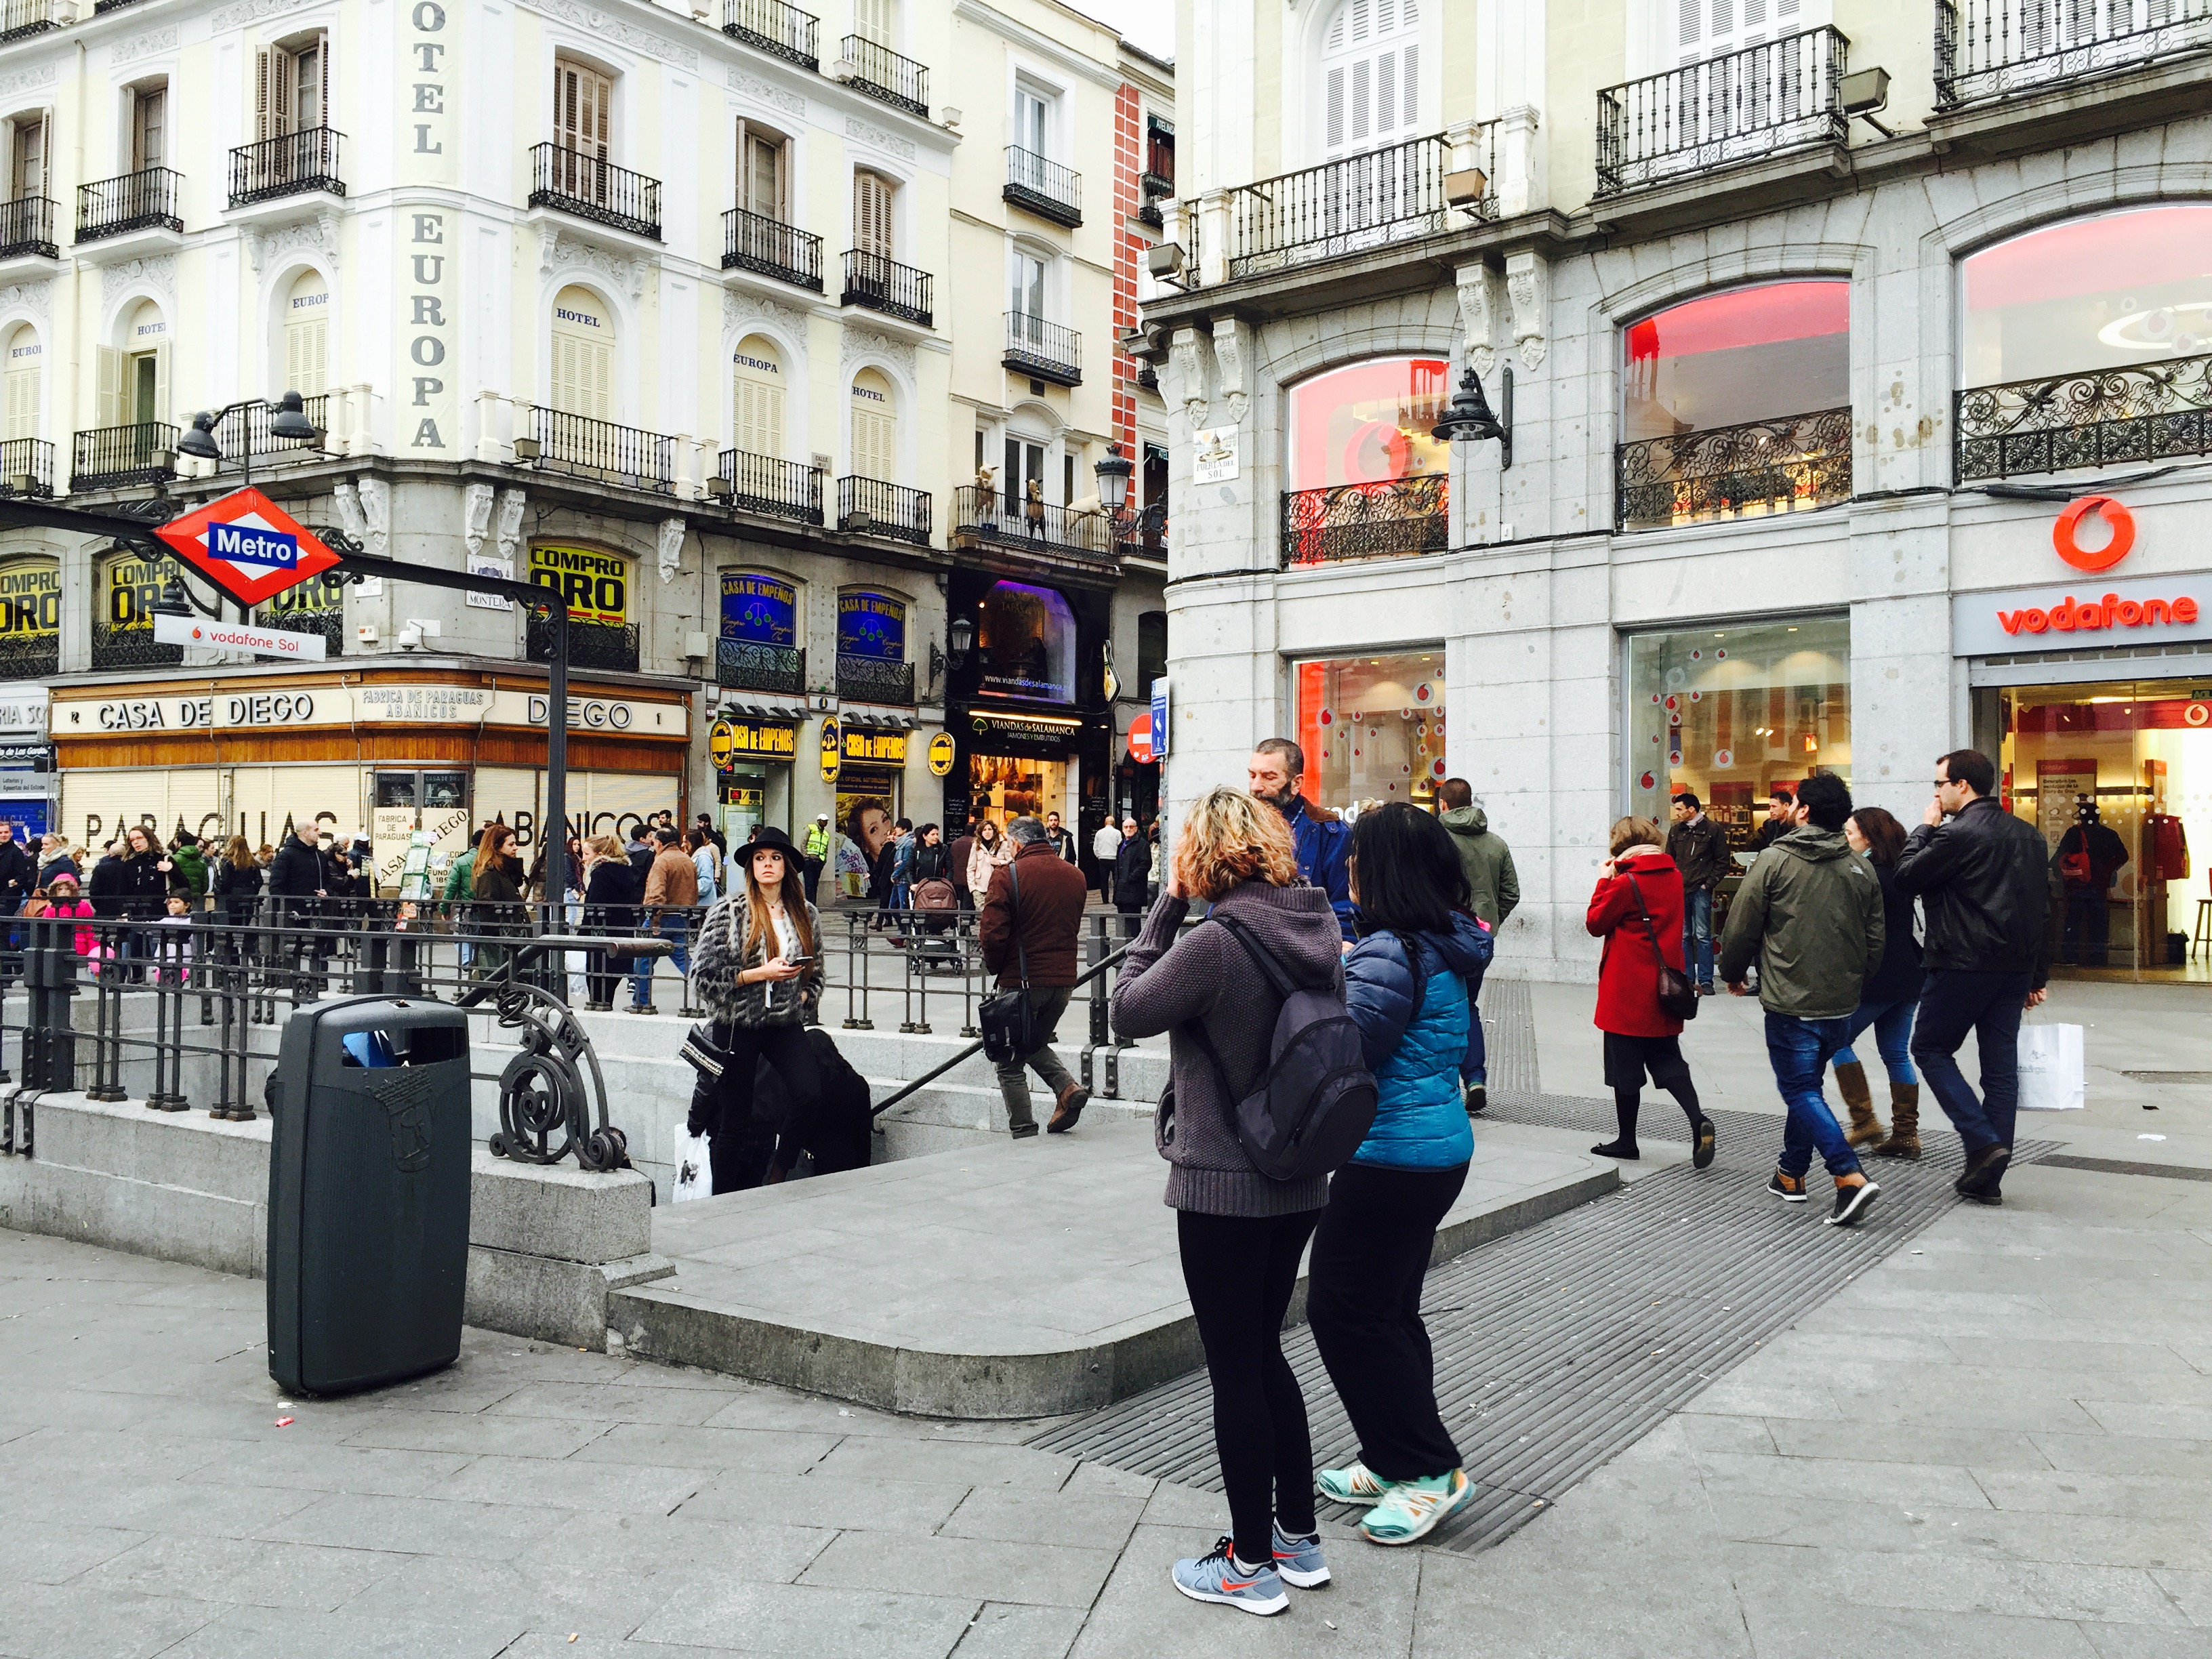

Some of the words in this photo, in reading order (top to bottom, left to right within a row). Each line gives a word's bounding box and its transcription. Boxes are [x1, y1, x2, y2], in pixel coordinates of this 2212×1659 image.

[556, 308, 600, 327] HOTEL
[411, 213, 446, 448] EUROPA
[733, 353, 779, 373] EUROPA
[852, 386, 885, 403] HOTEL
[1197, 462, 1223, 471] PUERTA
[1208, 470, 1225, 479] SOL
[217, 528, 291, 561] Metro
[531, 548, 624, 577] COMPRO
[0, 571, 60, 594] OMPRO
[530, 568, 624, 612] ORO
[721, 580, 745, 596] CASA
[746, 581, 756, 595] DE
[758, 583, 794, 605] EMPEÑOS
[839, 598, 859, 613] CASA
[861, 599, 869, 612] DE
[871, 600, 903, 621] EMPEÑOS
[1996, 593, 2198, 635] vodafone
[209, 631, 274, 649] vodafone
[279, 638, 299, 651] Sol
[363, 690, 403, 704] FABRICA
[407, 690, 422, 703] DE
[426, 691, 483, 705] PARAGUAS
[98, 701, 164, 729] CASA
[179, 699, 211, 726] DE
[228, 693, 314, 724] DIEGO
[386, 704, 457, 718] ABANICOS
[528, 695, 632, 729] DEGO
[733, 724, 749, 750] ASA
[750, 731, 758, 750] DE
[759, 726, 794, 752] EMPEÑOS
[991, 720, 1024, 731] VIANDAS
[1032, 724, 1075, 736] SALAMANCA
[1007, 732, 1029, 740] JAMONES
[847, 733, 865, 757] CASA
[865, 739, 872, 758] DE
[873, 734, 904, 759] EMPEÑOS
[378, 815, 407, 823] FABRICA
[387, 823, 396, 832] DE
[429, 810, 467, 846] IEGO
[375, 833, 411, 841] PARAGUAS
